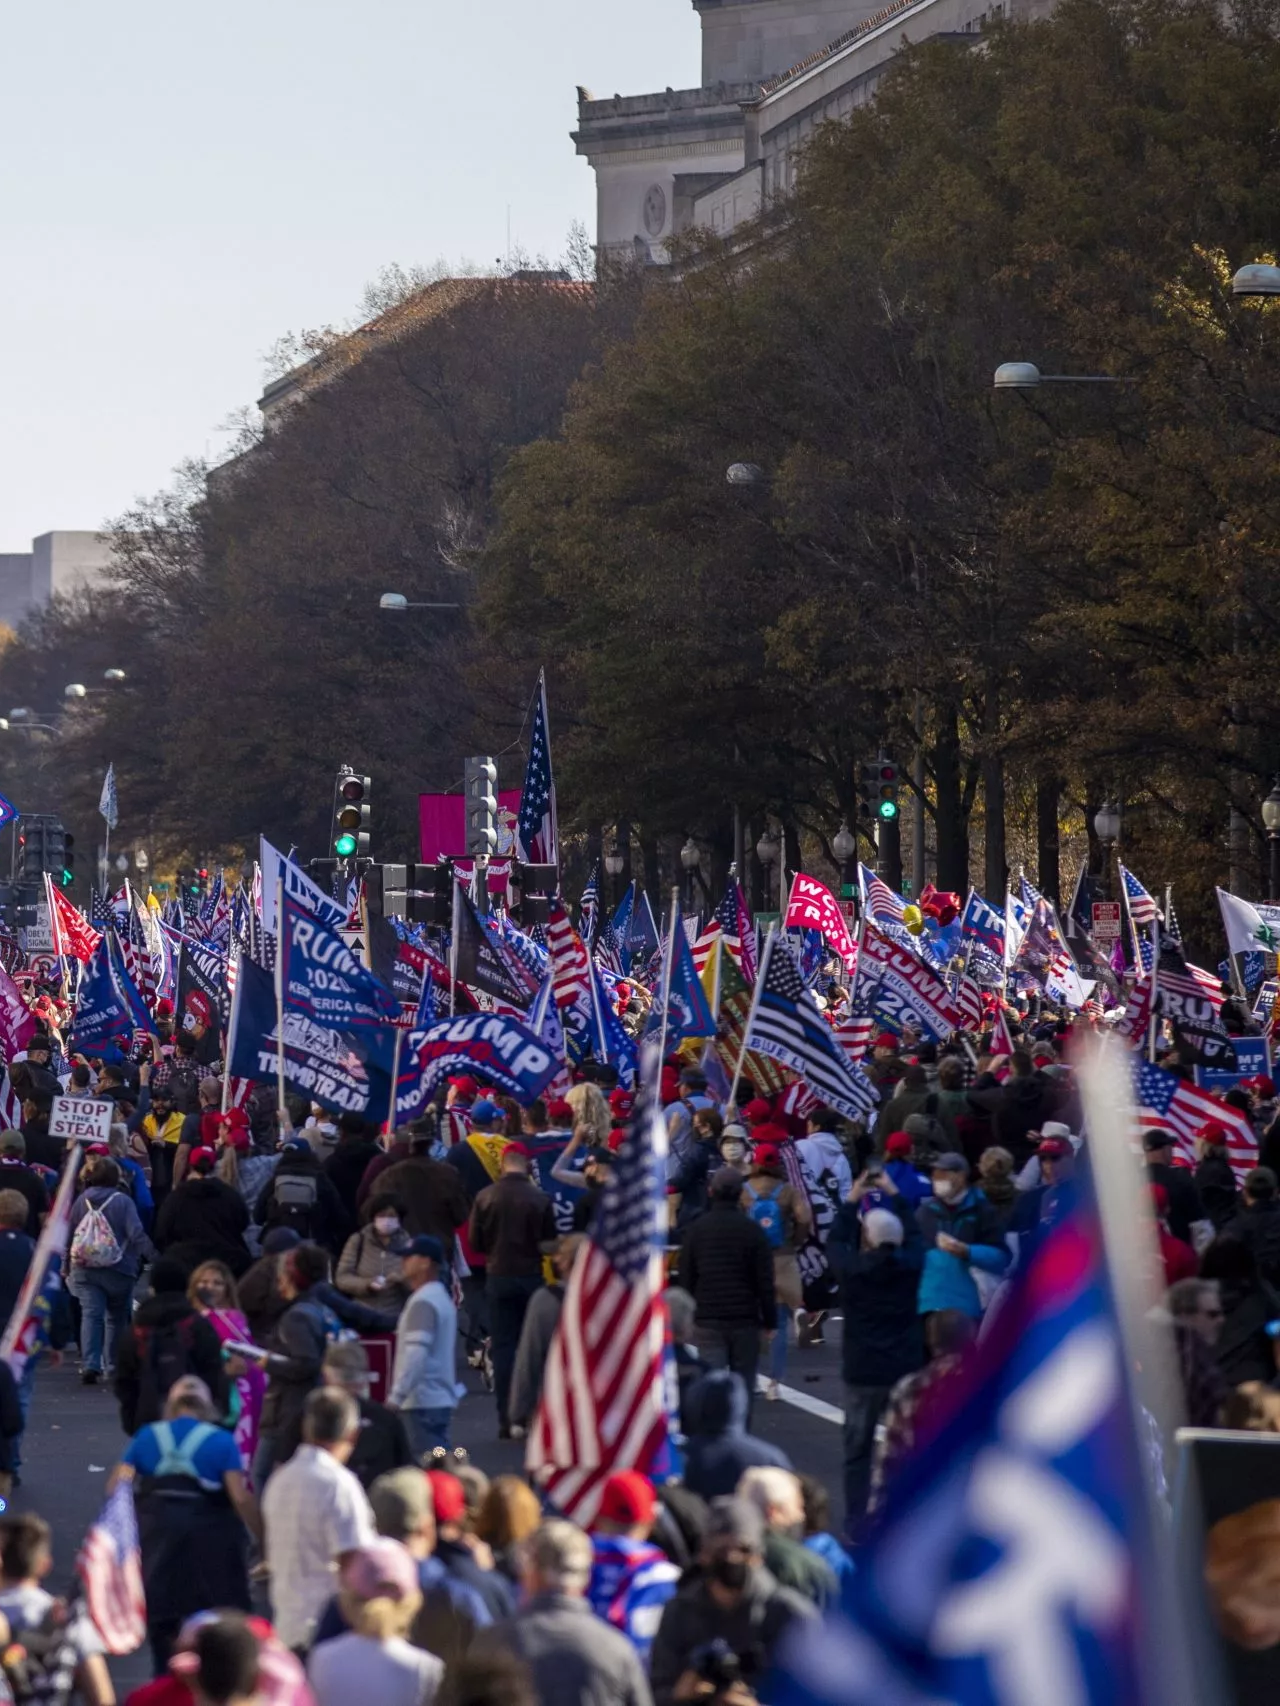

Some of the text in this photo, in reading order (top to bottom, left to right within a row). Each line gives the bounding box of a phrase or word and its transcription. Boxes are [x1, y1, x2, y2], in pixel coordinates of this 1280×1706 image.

[408, 1016, 551, 1077] TRUMP
[58, 1100, 108, 1117] STOP
[396, 1089, 421, 1112] NO
[72, 1115, 91, 1123] THE
[55, 1120, 105, 1138] STEAL
